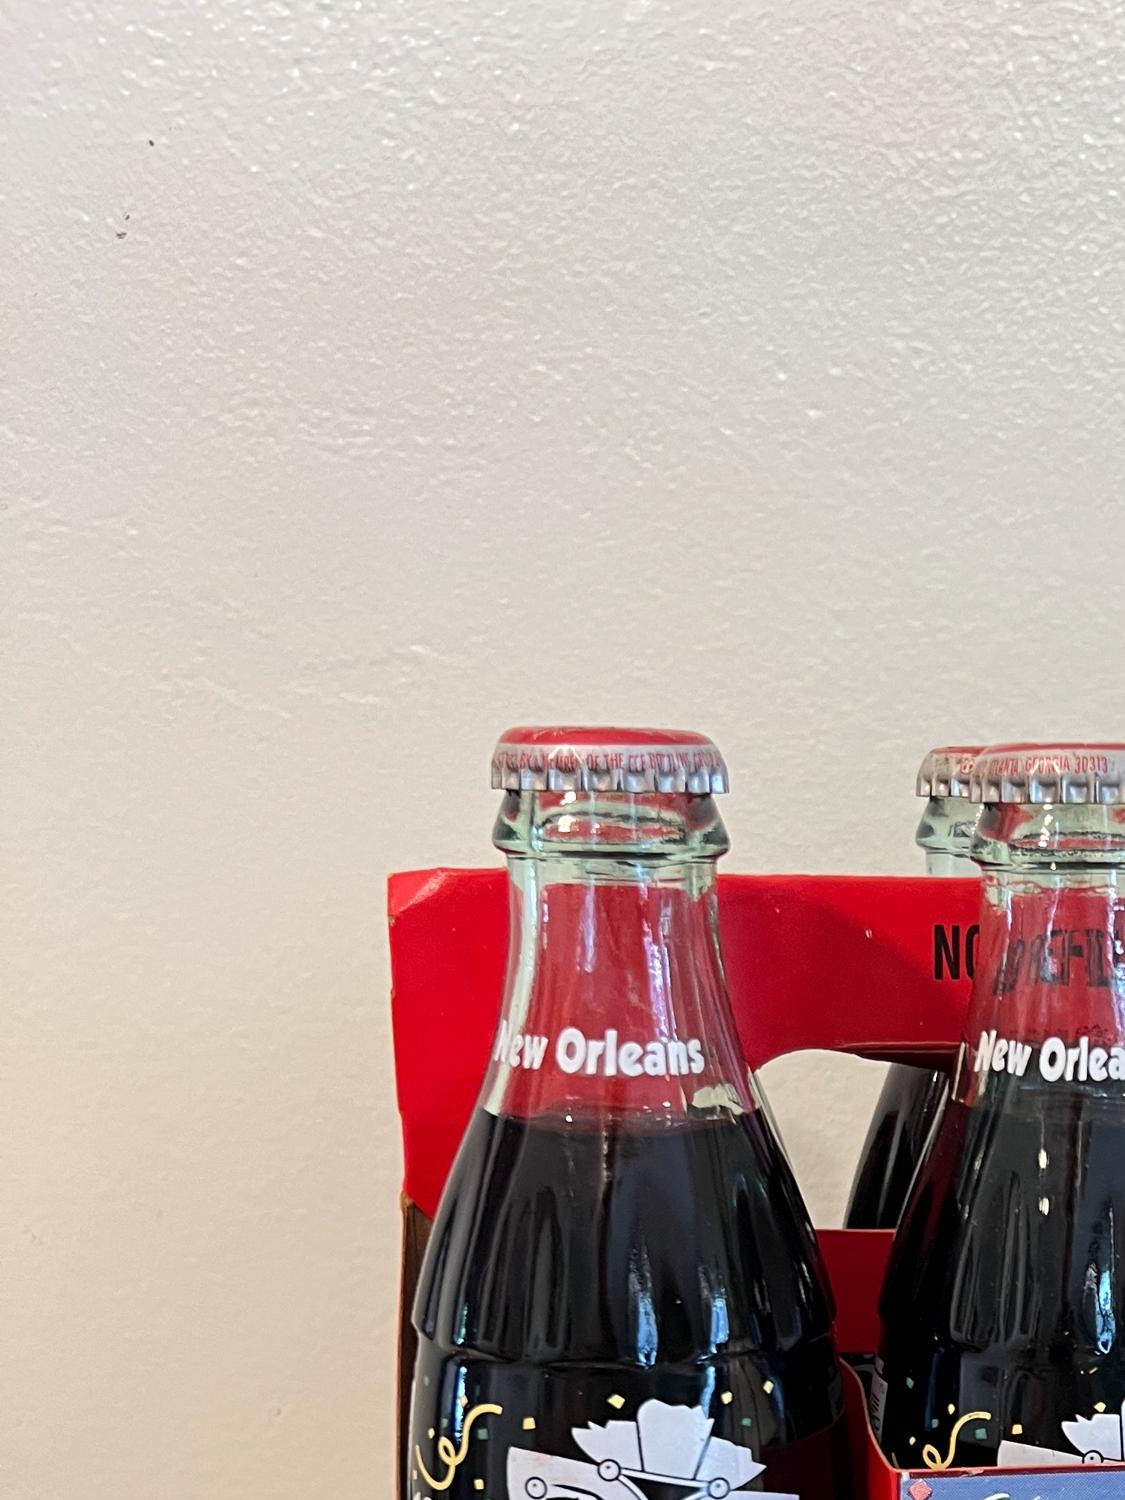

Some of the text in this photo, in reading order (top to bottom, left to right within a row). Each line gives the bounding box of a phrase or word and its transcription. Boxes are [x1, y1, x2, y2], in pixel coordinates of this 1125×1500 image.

[1074, 756, 1109, 775] 30313
[495, 1020, 704, 1077] New Orleans
[974, 1029, 1032, 1077] New
